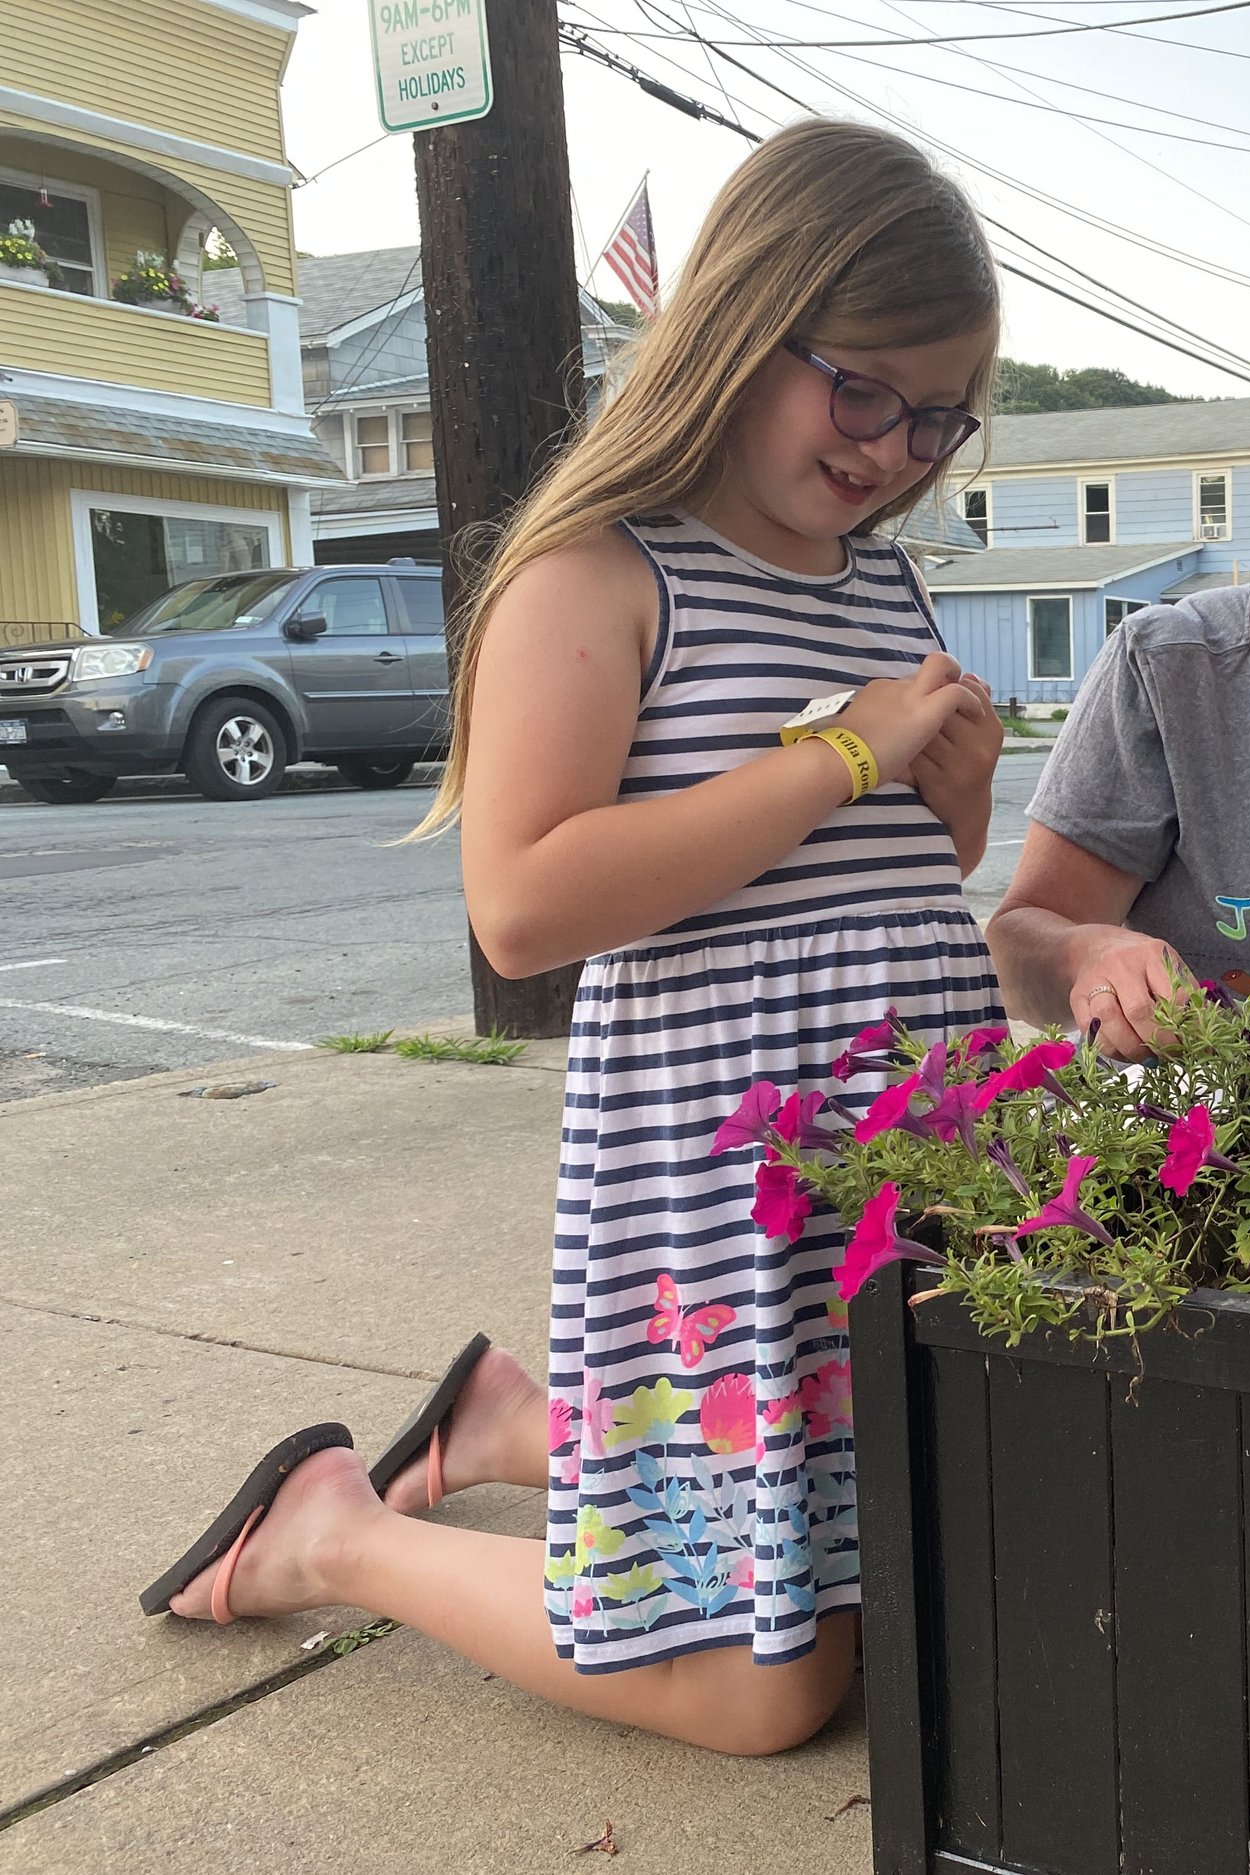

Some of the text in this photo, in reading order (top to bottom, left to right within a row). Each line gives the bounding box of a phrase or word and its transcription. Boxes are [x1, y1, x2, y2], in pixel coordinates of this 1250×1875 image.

[381, 0, 471, 34] 9AM-6PM
[401, 33, 455, 66] EXCEPT
[398, 67, 466, 101] HOLIDAYS
[835, 733, 870, 793] Villa Rom
